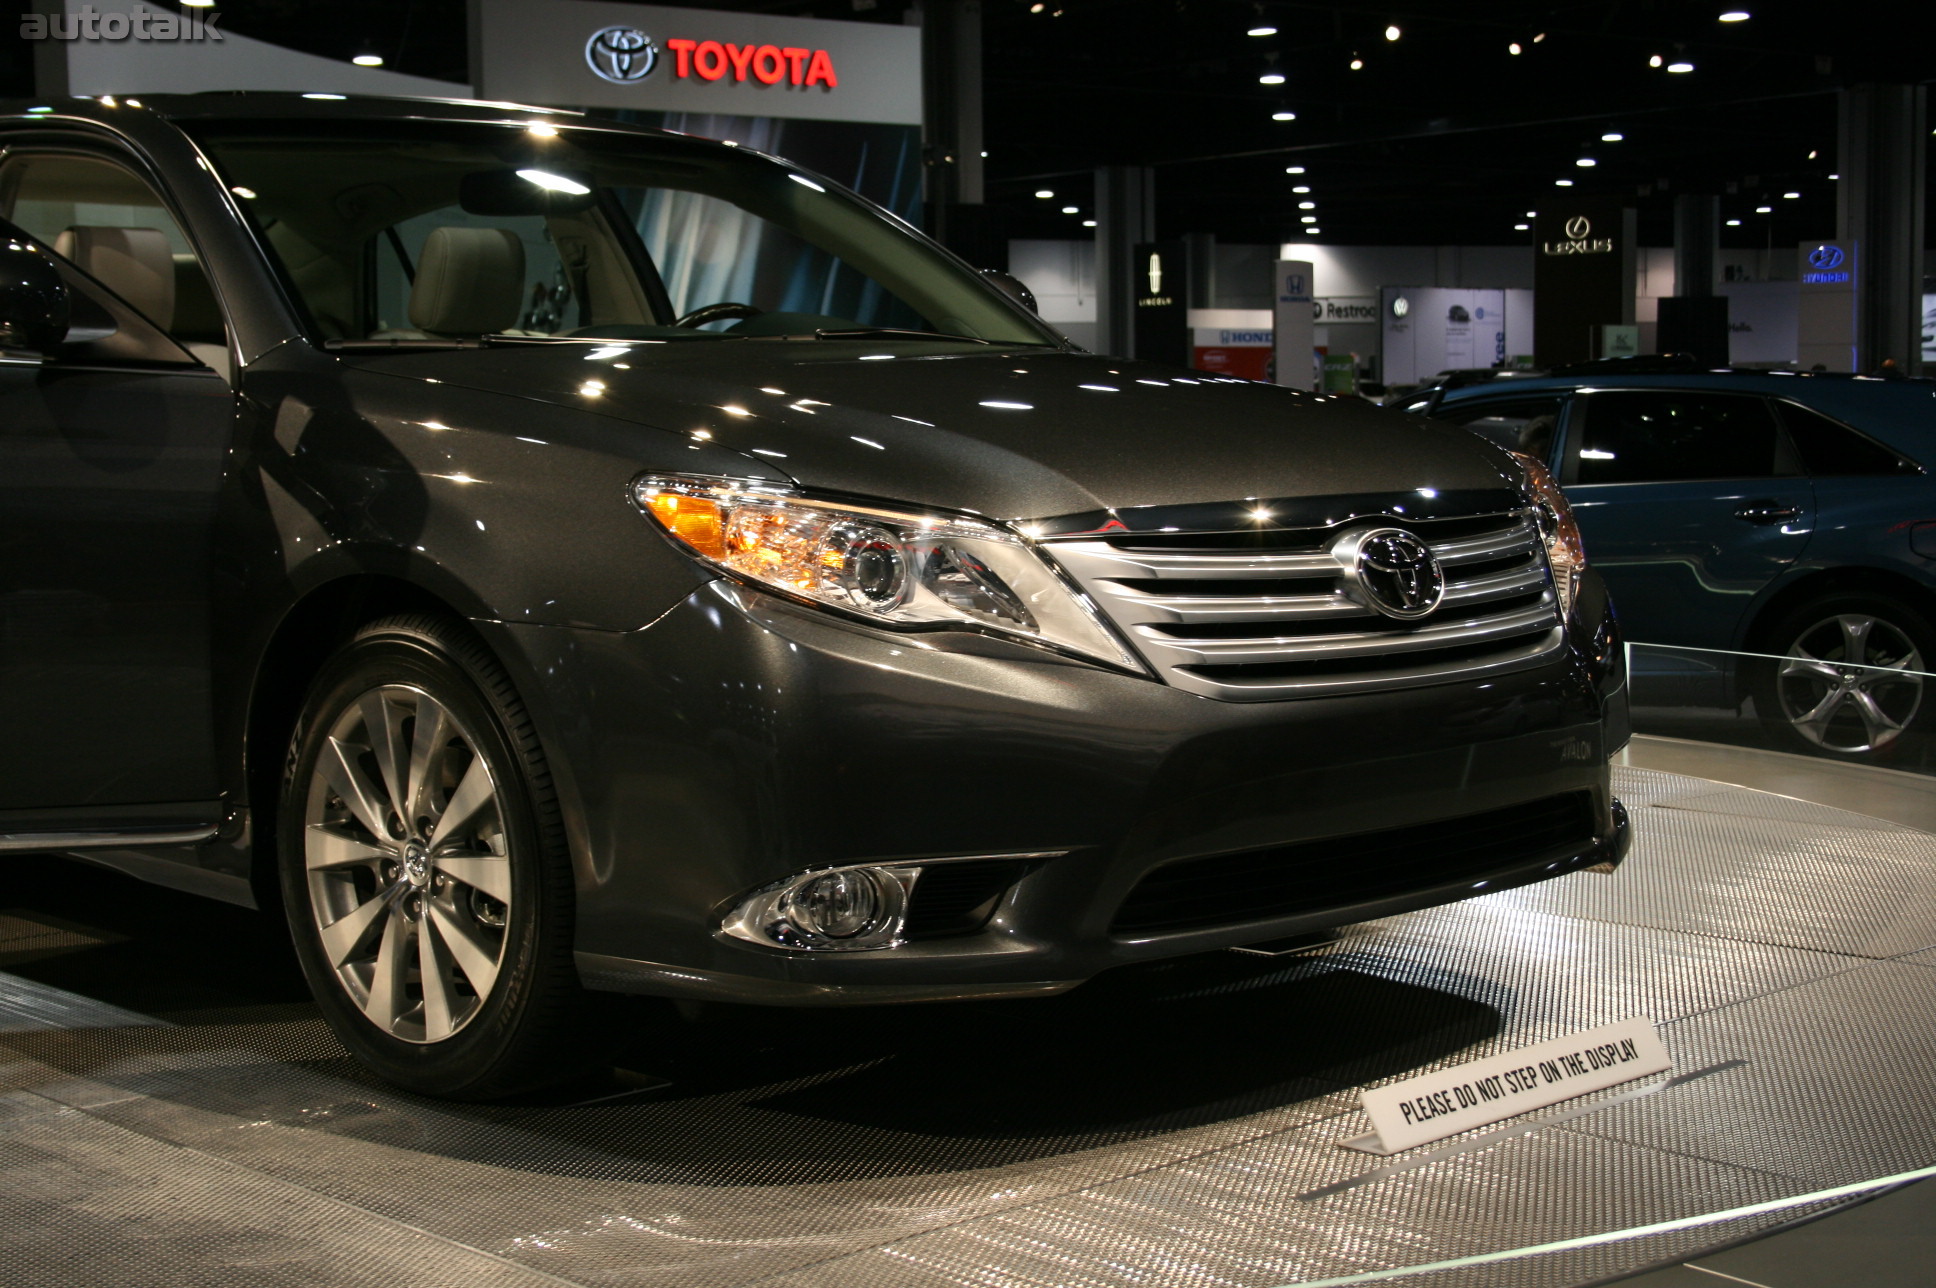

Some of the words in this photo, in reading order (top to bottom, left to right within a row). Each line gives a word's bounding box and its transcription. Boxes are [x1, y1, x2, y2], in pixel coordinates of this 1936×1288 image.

[667, 38, 838, 88] TOYOTA
[1544, 238, 1613, 255] LEXUS
[1327, 302, 1376, 318] Restroo
[1231, 332, 1273, 343] HOND
[1399, 1089, 1457, 1126] PLEASE
[1452, 1083, 1478, 1109] DO
[1475, 1074, 1506, 1102] NOT
[1504, 1066, 1538, 1094] STEP
[1538, 1059, 1563, 1084] ON
[1557, 1051, 1589, 1078] THE
[1584, 1037, 1639, 1071] DISPLAY
